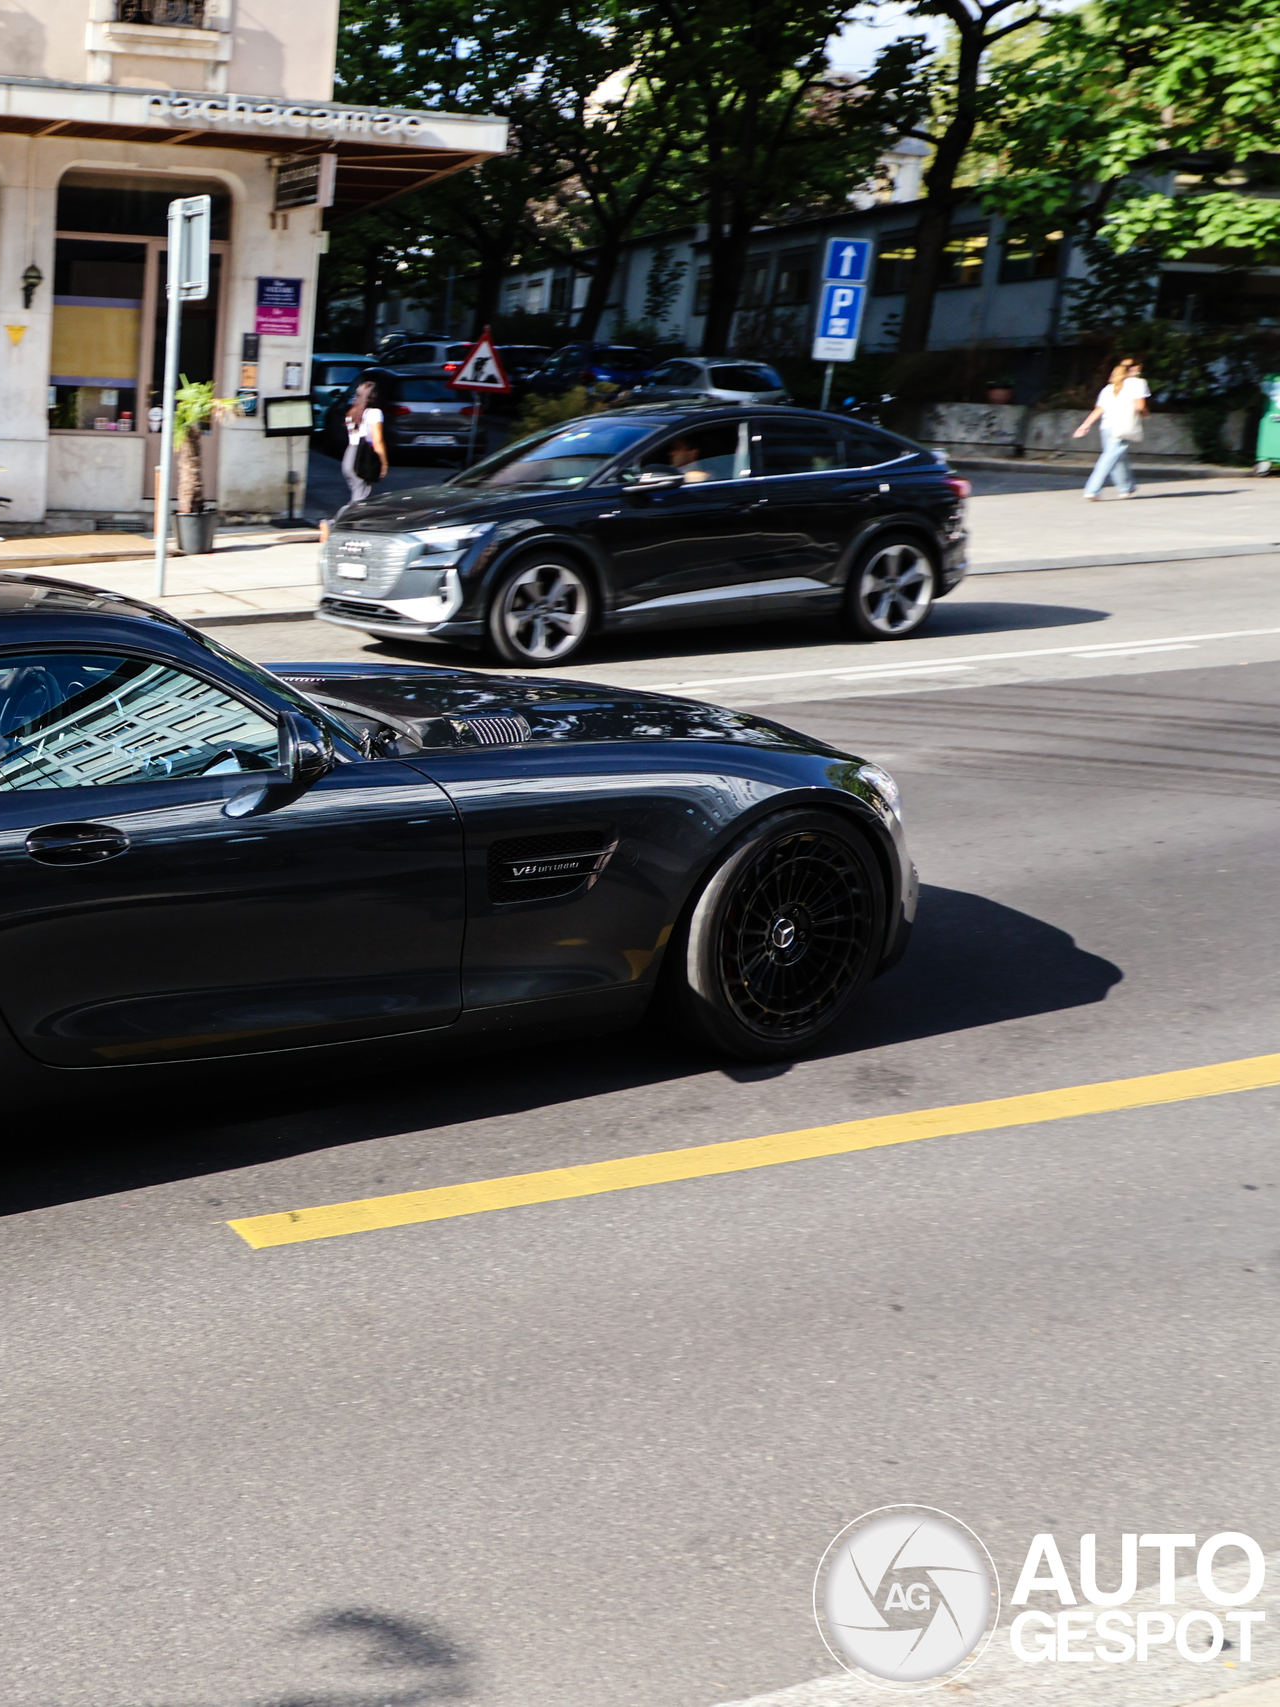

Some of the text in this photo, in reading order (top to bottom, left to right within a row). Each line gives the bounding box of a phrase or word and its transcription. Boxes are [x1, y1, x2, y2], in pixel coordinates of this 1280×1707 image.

[142, 93, 424, 136] pachacamac
[830, 288, 855, 316] P
[513, 864, 537, 876] V8
